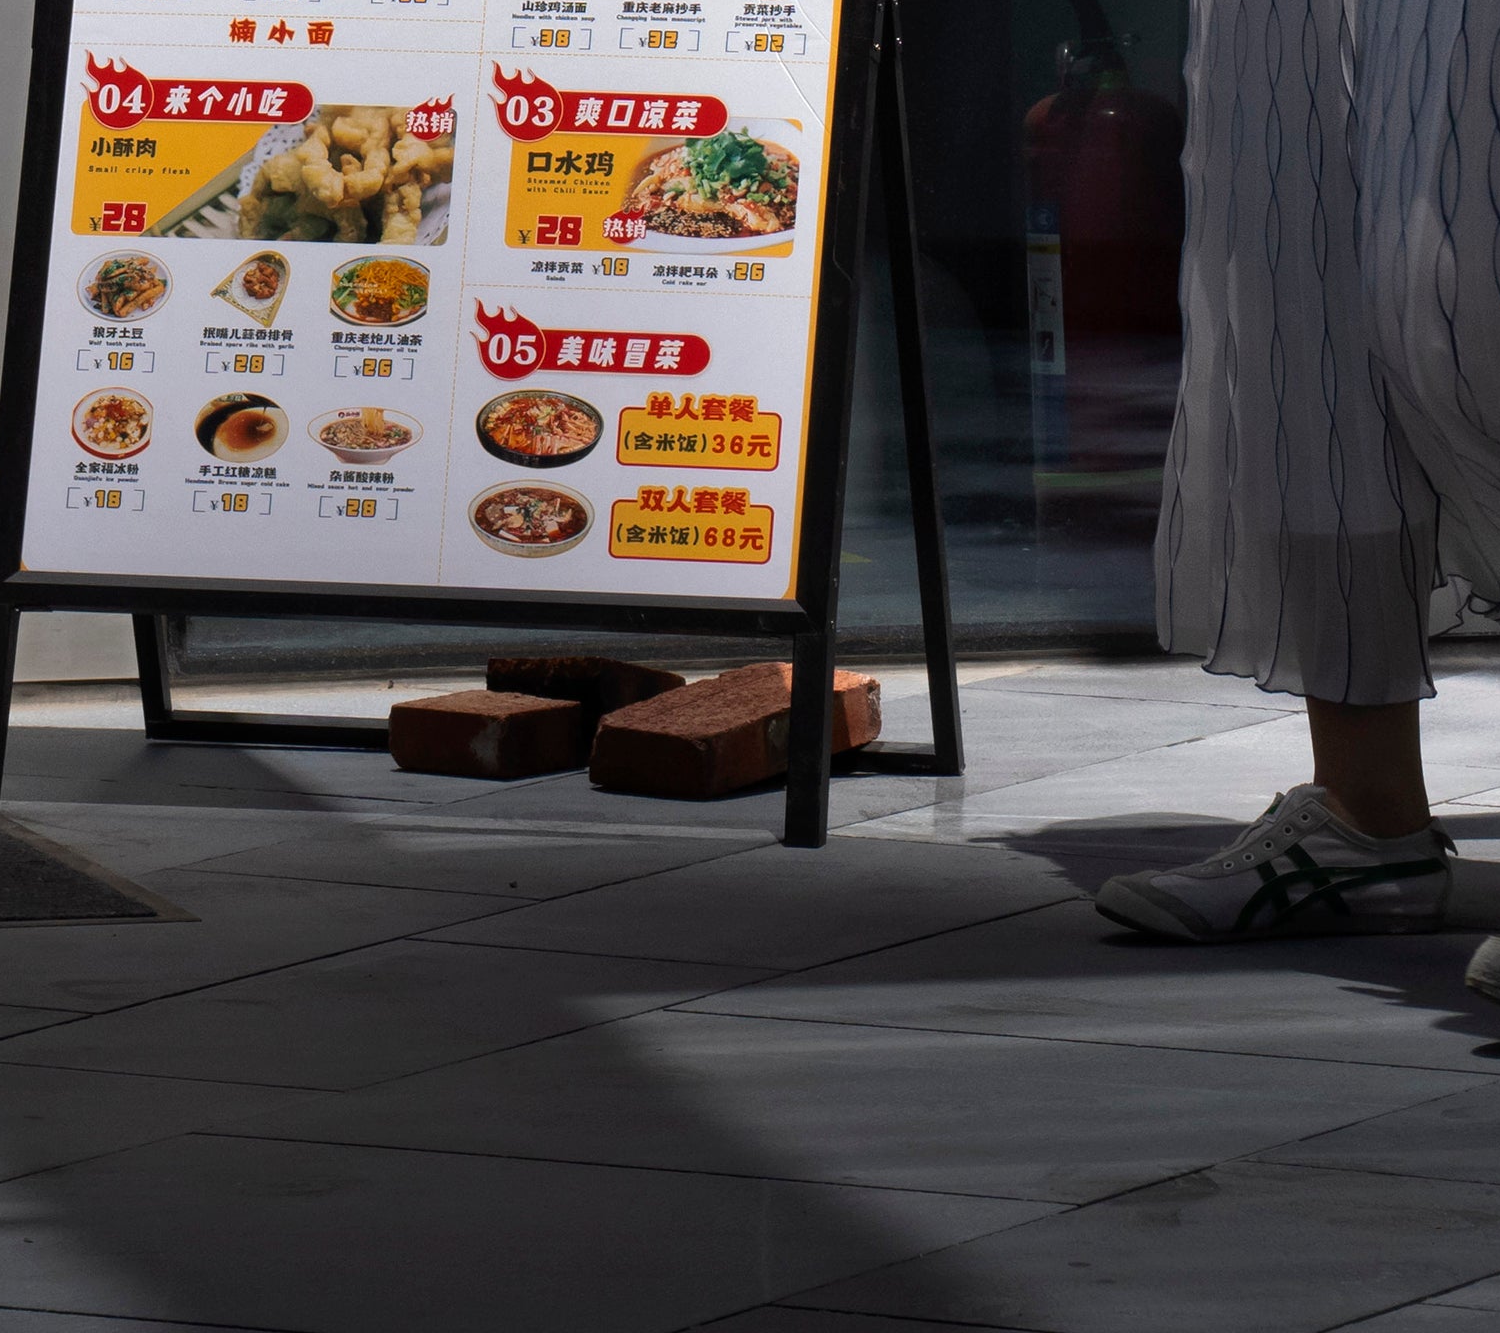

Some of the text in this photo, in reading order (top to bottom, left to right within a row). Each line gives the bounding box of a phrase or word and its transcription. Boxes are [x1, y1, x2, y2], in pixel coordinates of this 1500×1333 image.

[522, 1, 587, 13] 山珍鸡汤面
[623, 1, 701, 14] 重庆老麻抄手
[743, 4, 796, 16] 贡菜抄手
[98, 84, 289, 117] 04 来个小吃
[406, 109, 454, 133] 热销
[506, 96, 702, 131] 03 爽口凉菜
[91, 137, 156, 158] 小酥肉
[89, 165, 118, 173] Small
[126, 166, 154, 175] crisp
[527, 151, 614, 177] 口水鸡
[603, 218, 646, 239] 热销
[531, 260, 583, 274] 凉拌贡菜
[93, 326, 143, 339] 狼牙土豆
[488, 333, 684, 369] 05 美味冒菜
[648, 396, 755, 422] 单人套餐
[640, 489, 747, 515] 双人套餐
